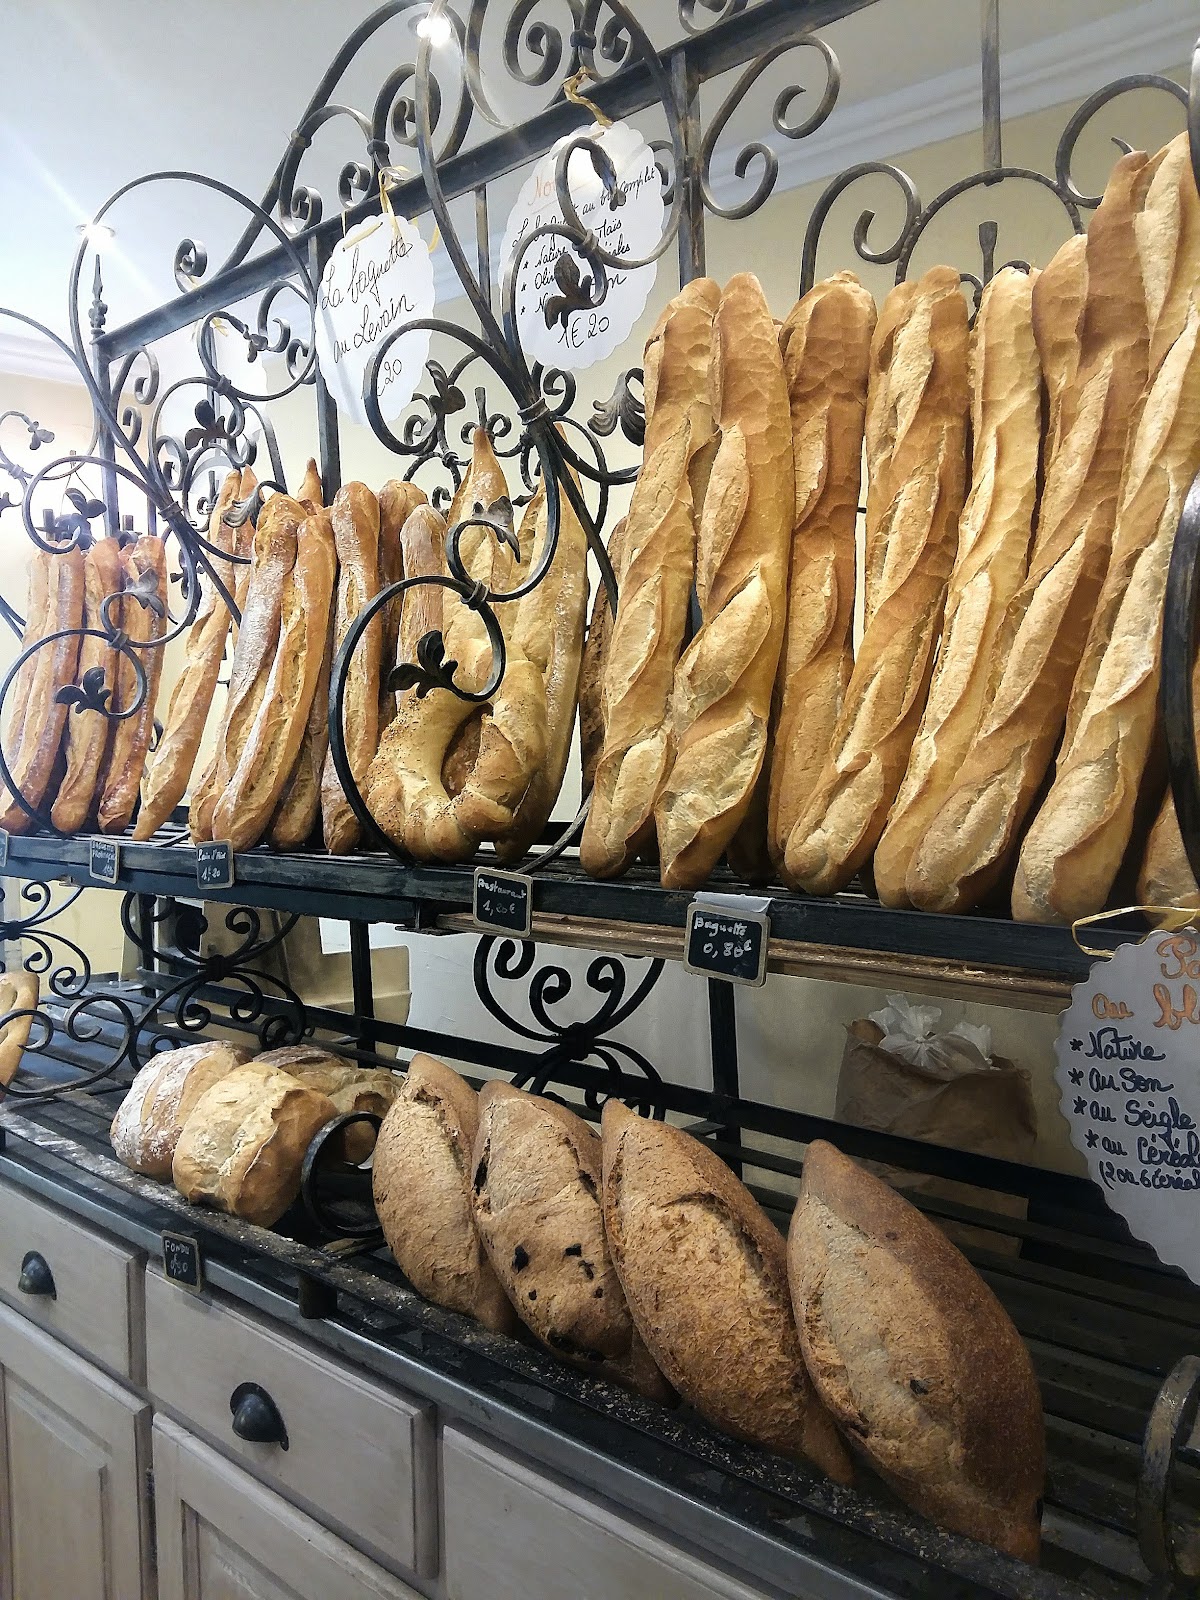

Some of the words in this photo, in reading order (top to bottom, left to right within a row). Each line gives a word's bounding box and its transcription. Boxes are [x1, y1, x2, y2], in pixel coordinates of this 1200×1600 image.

[583, 203, 595, 215] au
[333, 340, 350, 364] au
[694, 917, 747, 937] Baguette
[1153, 984, 1200, 1030] bl
[1085, 1027, 1166, 1060] Nature
[1119, 1067, 1174, 1092] Son
[1125, 1096, 1197, 1151] Seigle
[1137, 1130, 1200, 1168] Céréal
